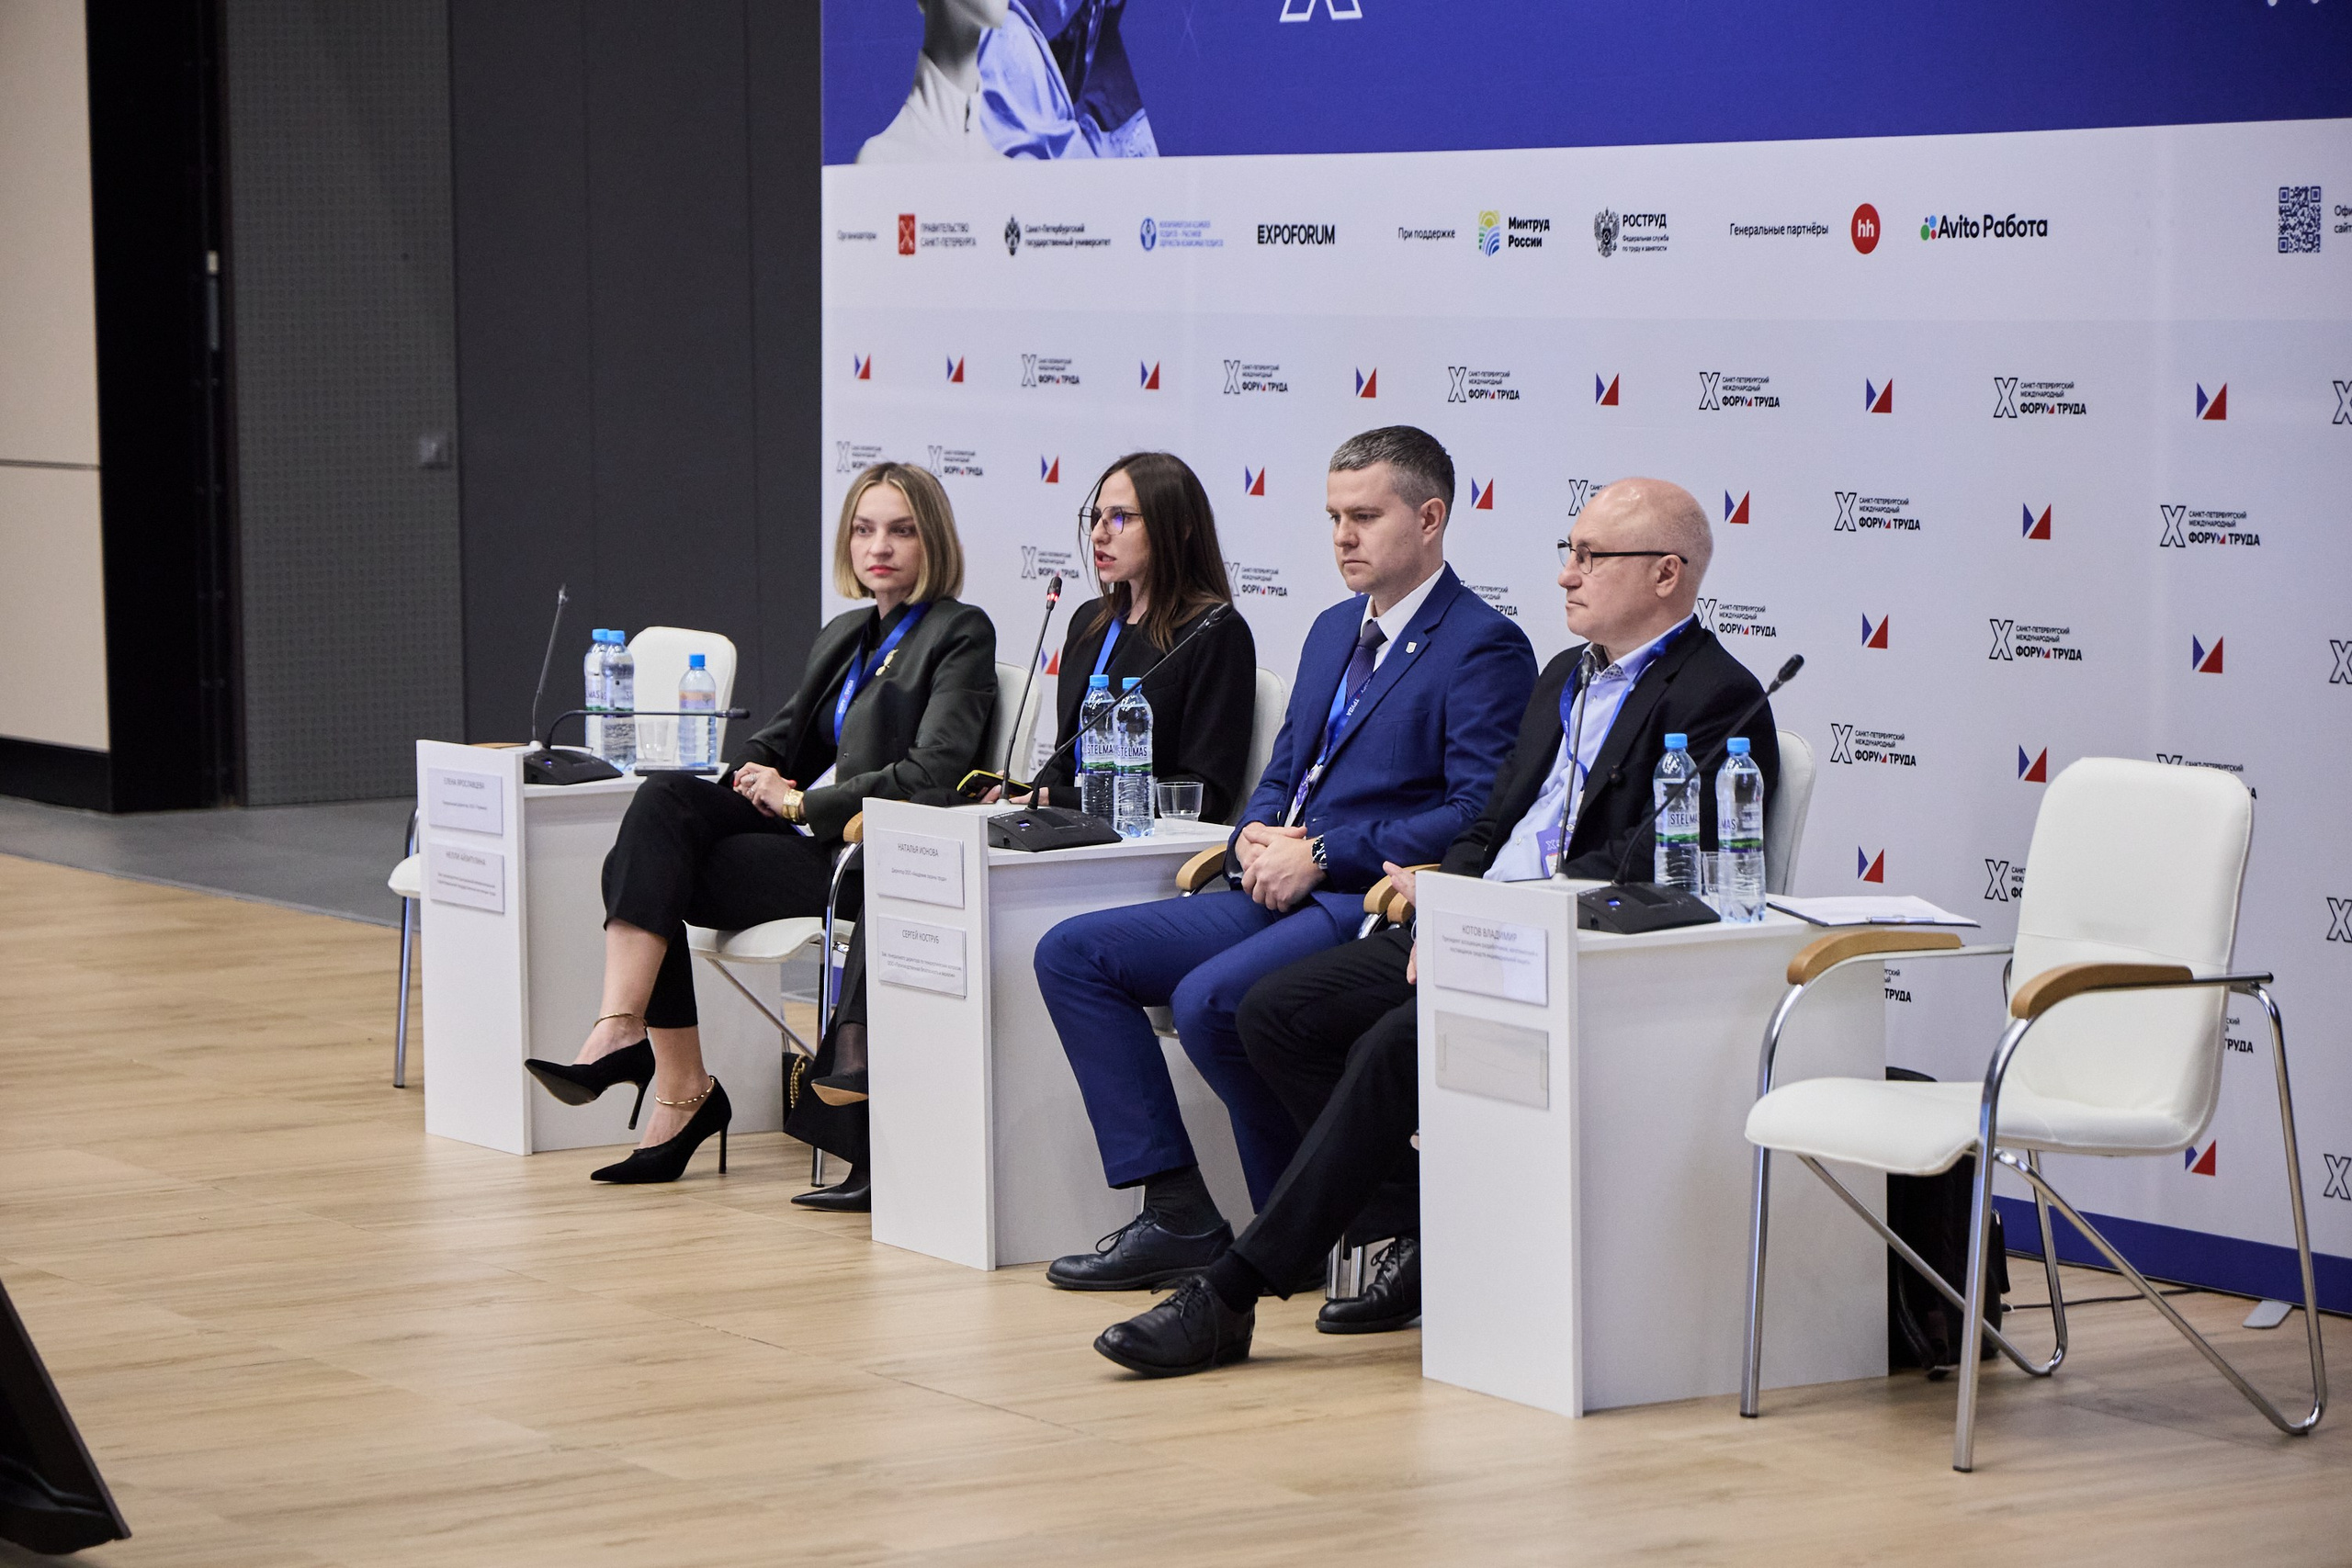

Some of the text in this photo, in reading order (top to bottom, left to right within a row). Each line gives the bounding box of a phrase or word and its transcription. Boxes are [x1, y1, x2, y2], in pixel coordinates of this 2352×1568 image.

[1509, 217, 1550, 232] Минтруд
[1623, 214, 1668, 229] РОСТРУД
[1938, 215, 1979, 239] Avito
[1983, 213, 2049, 239] Работа
[1025, 223, 1085, 234] Санкт-Петербургский
[1257, 224, 1336, 244] EXPOFORUM
[1398, 227, 1456, 241] При поддержке
[1730, 222, 1829, 238] Генеральные партнёры
[1857, 220, 1875, 237] hh
[921, 237, 977, 246] САНКТ-ПЕТЕРБУРГА
[1025, 237, 1111, 248] государственный университет
[1509, 234, 1543, 248] России
[1652, 234, 1669, 243] служба
[1242, 379, 1288, 392] ФОРУМ ТРУДА
[1722, 377, 1770, 385] САНКТ-ПЕТЕРБУРГСКИЙ
[2020, 381, 2075, 390] САНКТ-ПЕТЕРБУРГСКИЙ
[1469, 389, 1521, 400] ФОРУМ ТРУДА
[1722, 384, 1761, 392] МЕЖДУНАРОДНЫЙ
[2020, 390, 2065, 399] МЕЖДУНАРОДНЫЙ
[1722, 395, 1781, 408] ФОРУМ ТРУДА
[2019, 401, 2087, 416] ФОРУМ ТРУДА
[1859, 496, 1910, 506] САНКТ-ПЕТЕРБУРГСКИЙ
[1859, 505, 1900, 514] МЕЖДУНАРОДНЫЙ
[2188, 510, 2247, 520] САНКТ-ПЕТЕРБУРГСКИЙ
[1859, 515, 1921, 532] ФОРУМ ТРУДА
[2188, 519, 2237, 528] МЕЖДУНАРОДНЫЙ
[2188, 531, 2261, 547] ФОРУМ ТРУДА
[1267, 585, 1288, 597] ТРУДА
[1719, 603, 1767, 613] САНКТ-ПЕТЕРБУРГСКИЙ
[1719, 612, 1758, 621] МЕЖДУНАРОДНЫЙ
[1719, 623, 1777, 637] ФОРУМ ТРУДА
[2016, 625, 2070, 635] САНКТ-ПЕТЕРБУРГСКИЙ
[2016, 634, 2061, 644] МЕЖДУНАРОДНЫЙ
[2015, 646, 2083, 662] ФОРУМ ТРУДА
[1345, 698, 1361, 716] ТРУДА
[1855, 729, 1905, 740] САНКТ-ПЕТЕРБУРГСКИЙ
[1855, 739, 1896, 749] МЕЖДУНАРОДНЫЙ
[1117, 745, 1148, 758] STELMAS
[1855, 749, 1917, 767] ФОРУМ ТРУДА
[898, 843, 939, 857] НАТАЛЬЯ ИОНОВА
[902, 930, 940, 944] СЕРГЕЙ КОСТРУБ
[1462, 924, 1518, 942] КОТОВ ВЛАДИМИР
[1884, 987, 1912, 1003] ТРУДА
